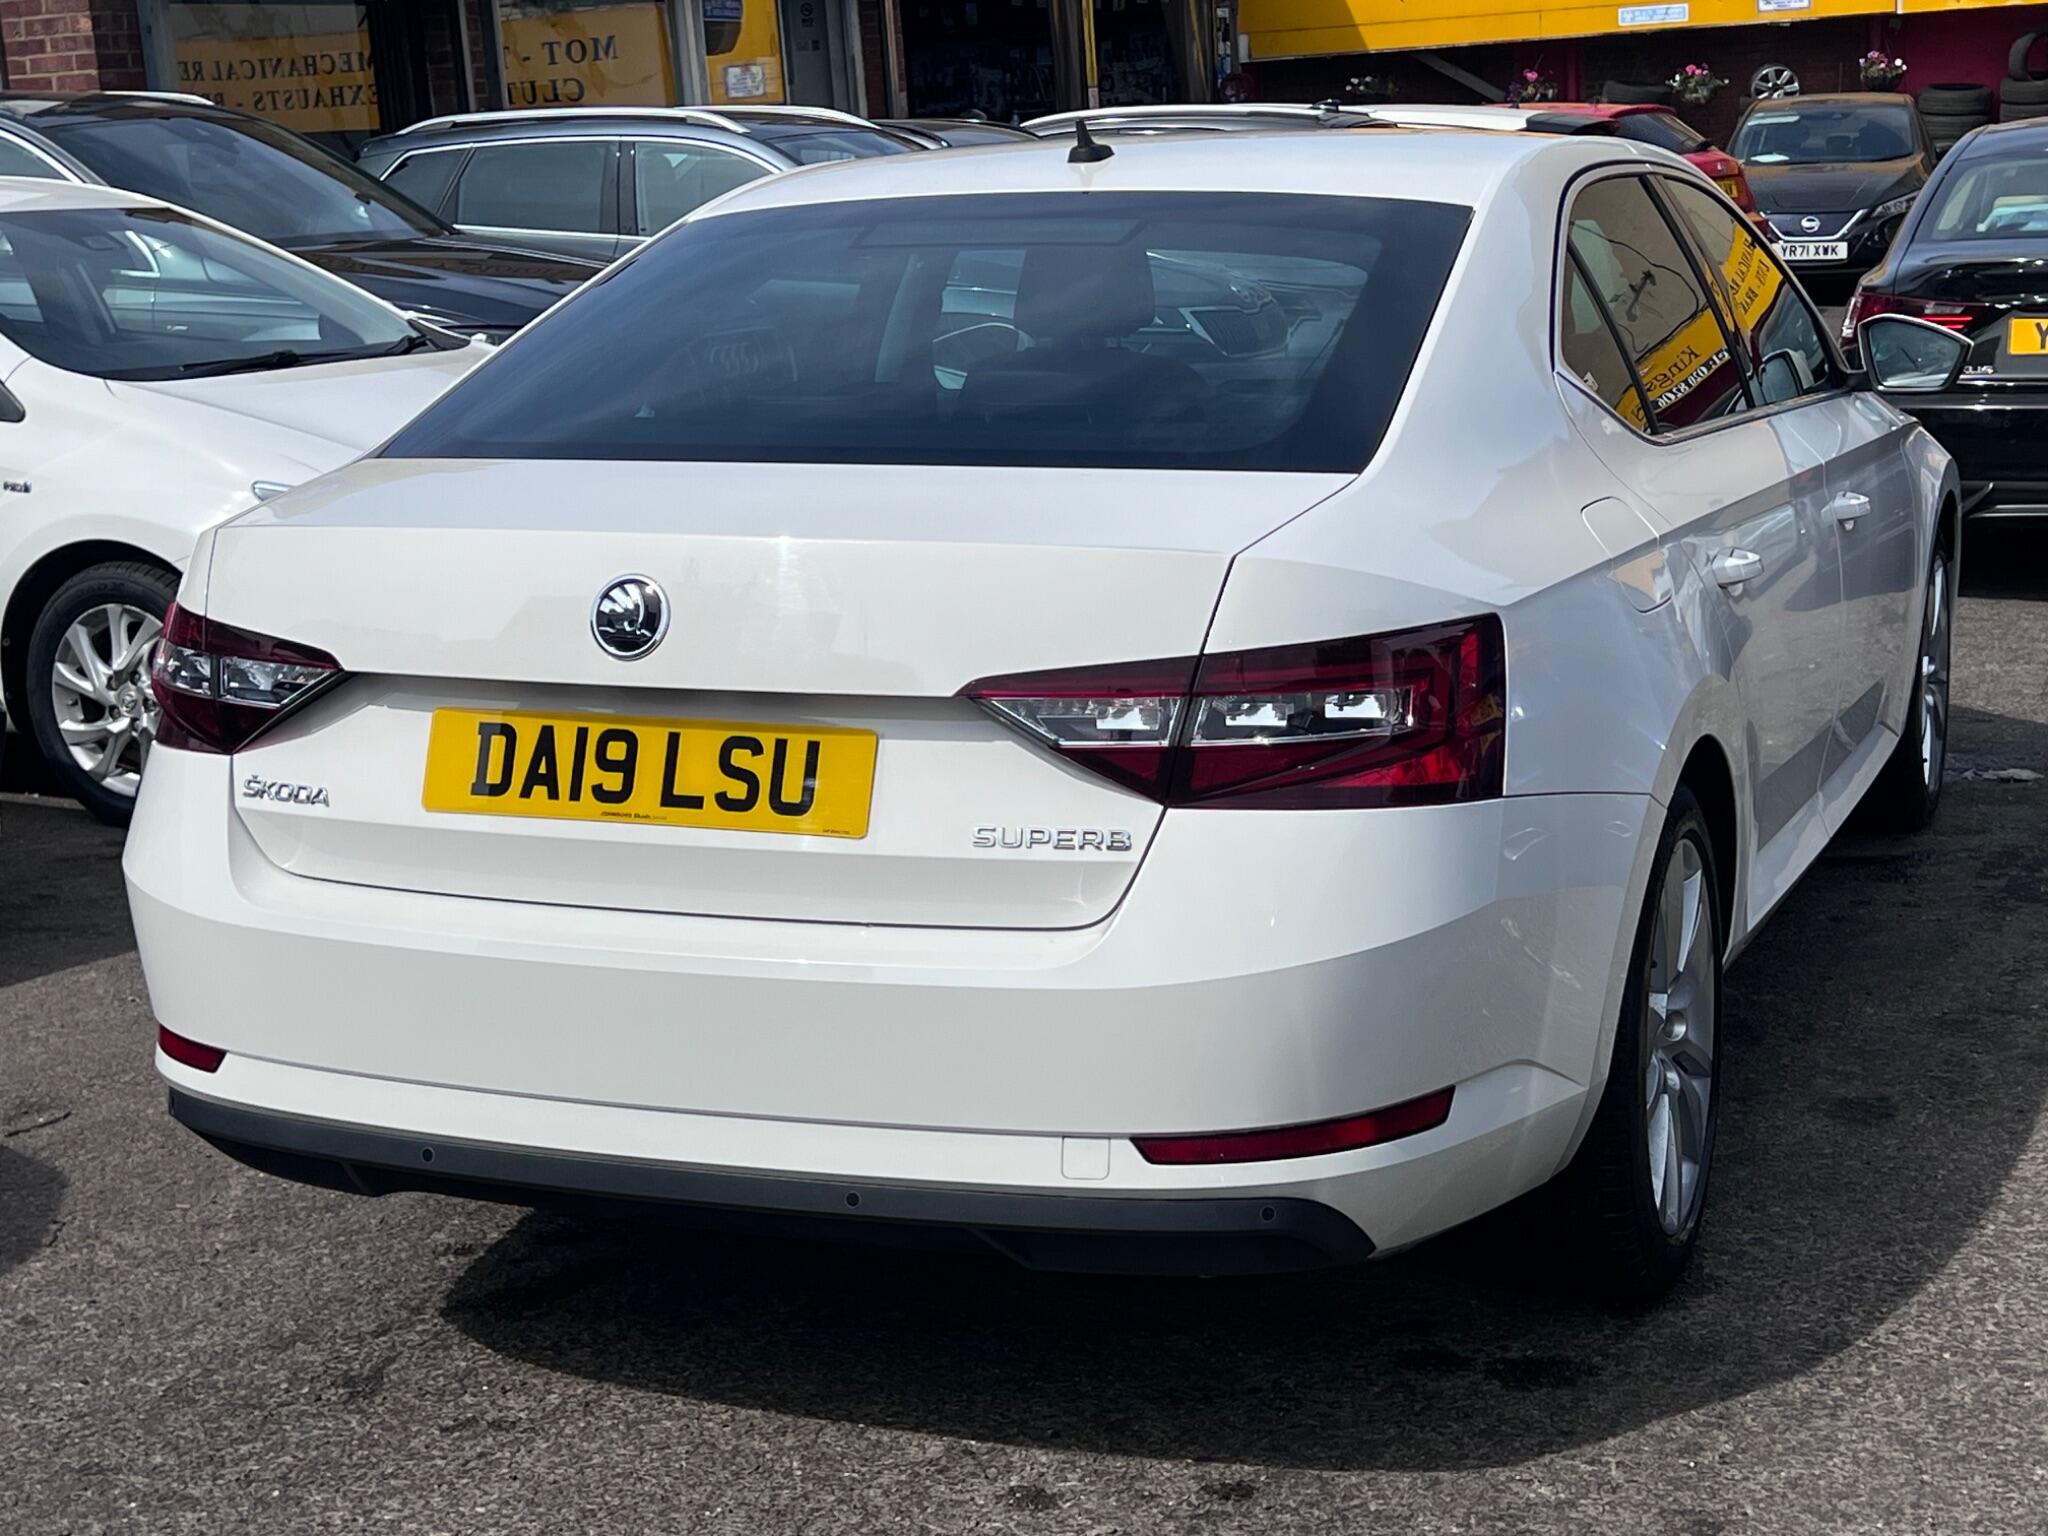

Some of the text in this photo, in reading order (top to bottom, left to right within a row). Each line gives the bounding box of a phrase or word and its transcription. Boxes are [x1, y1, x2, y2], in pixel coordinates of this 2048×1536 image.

[1781, 244, 1839, 257] YR71 XWK
[470, 721, 822, 818] DA19 LSU
[242, 774, 330, 808] ŠKODA
[972, 824, 1133, 851] SUPERB
